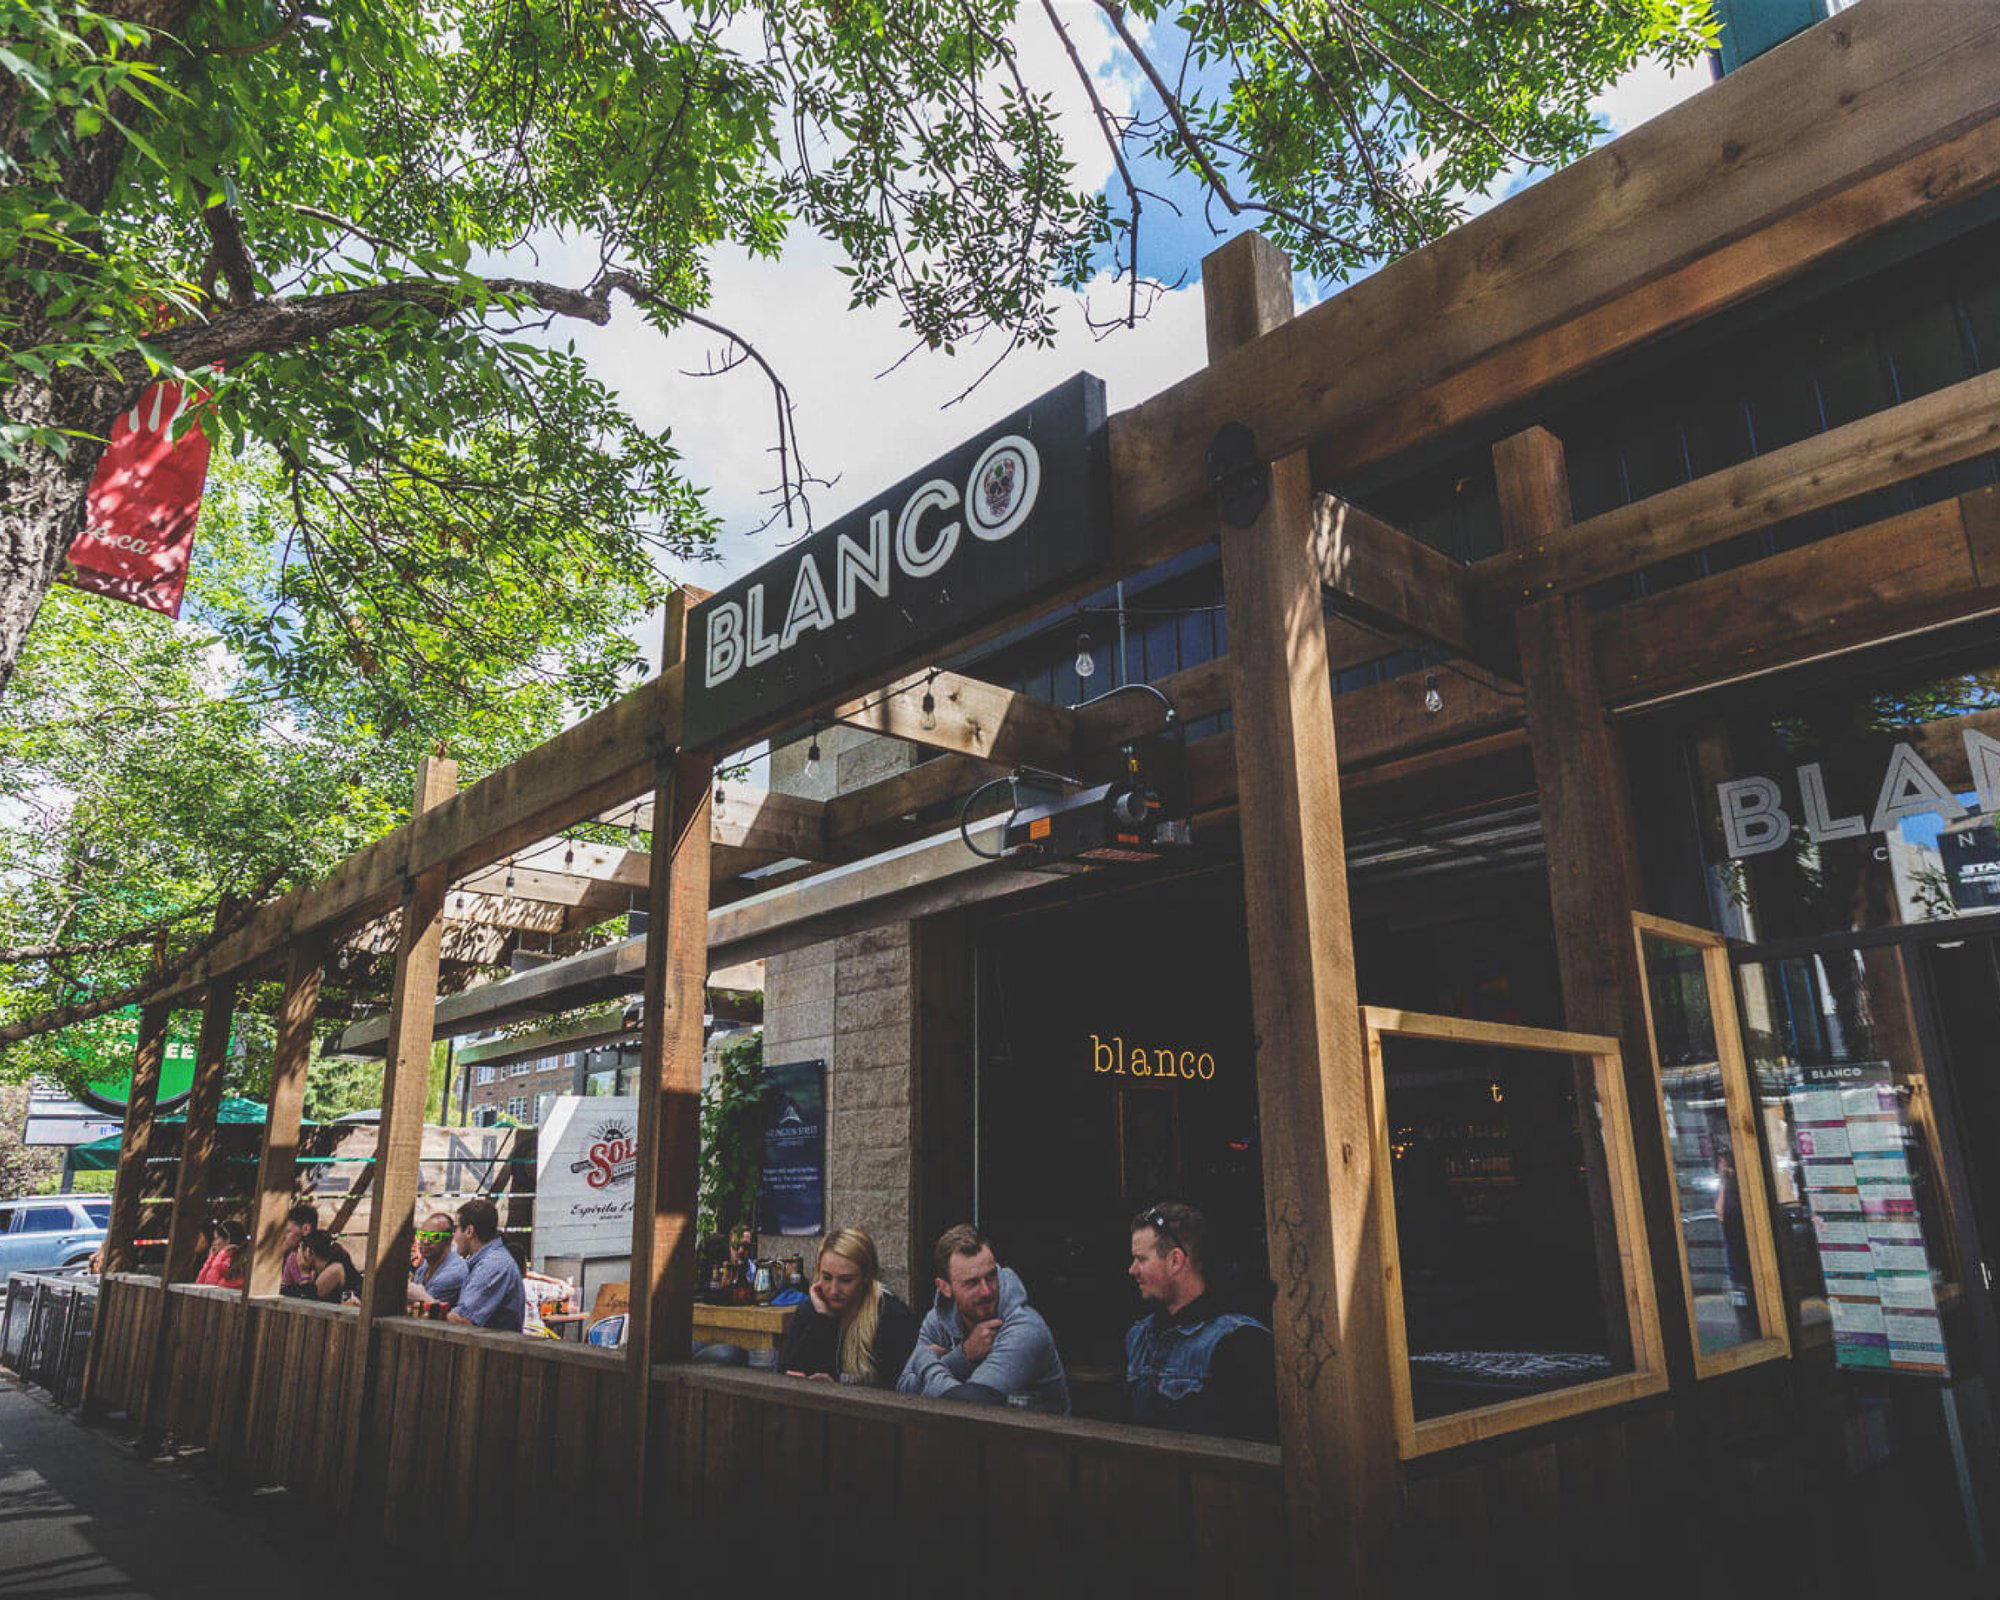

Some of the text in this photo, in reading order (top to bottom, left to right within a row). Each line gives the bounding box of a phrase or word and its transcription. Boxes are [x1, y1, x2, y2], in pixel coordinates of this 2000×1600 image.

[705, 435, 1041, 689] BLANCO
[1090, 1035, 1215, 1079] blanco
[1811, 1067, 1863, 1079] BLANCO
[587, 1138, 637, 1188] SOL
